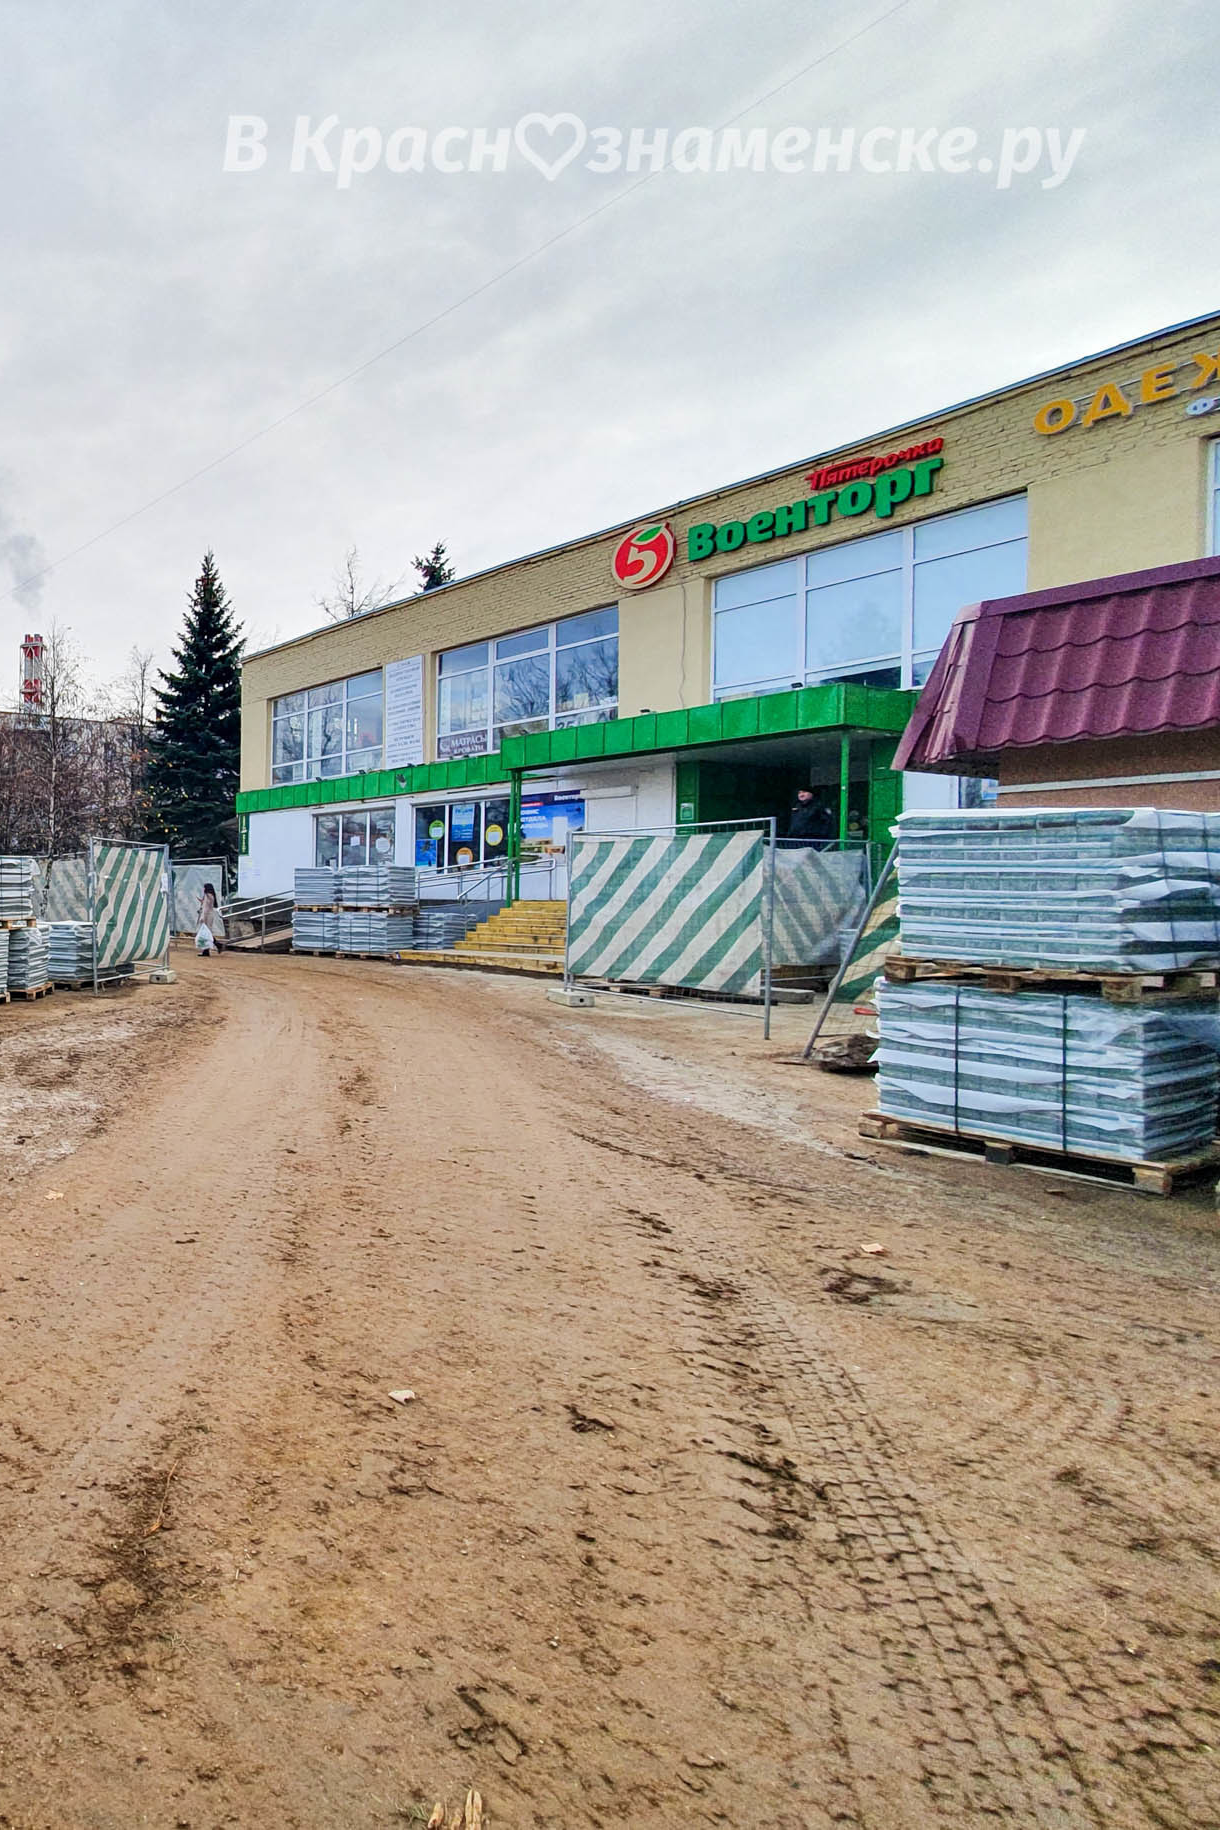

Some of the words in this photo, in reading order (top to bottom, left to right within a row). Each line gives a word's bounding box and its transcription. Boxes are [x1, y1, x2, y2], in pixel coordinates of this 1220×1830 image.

[805, 437, 944, 490] Пятерочка
[688, 458, 944, 562] Военторг
[451, 734, 487, 748] МАТРАСЫ
